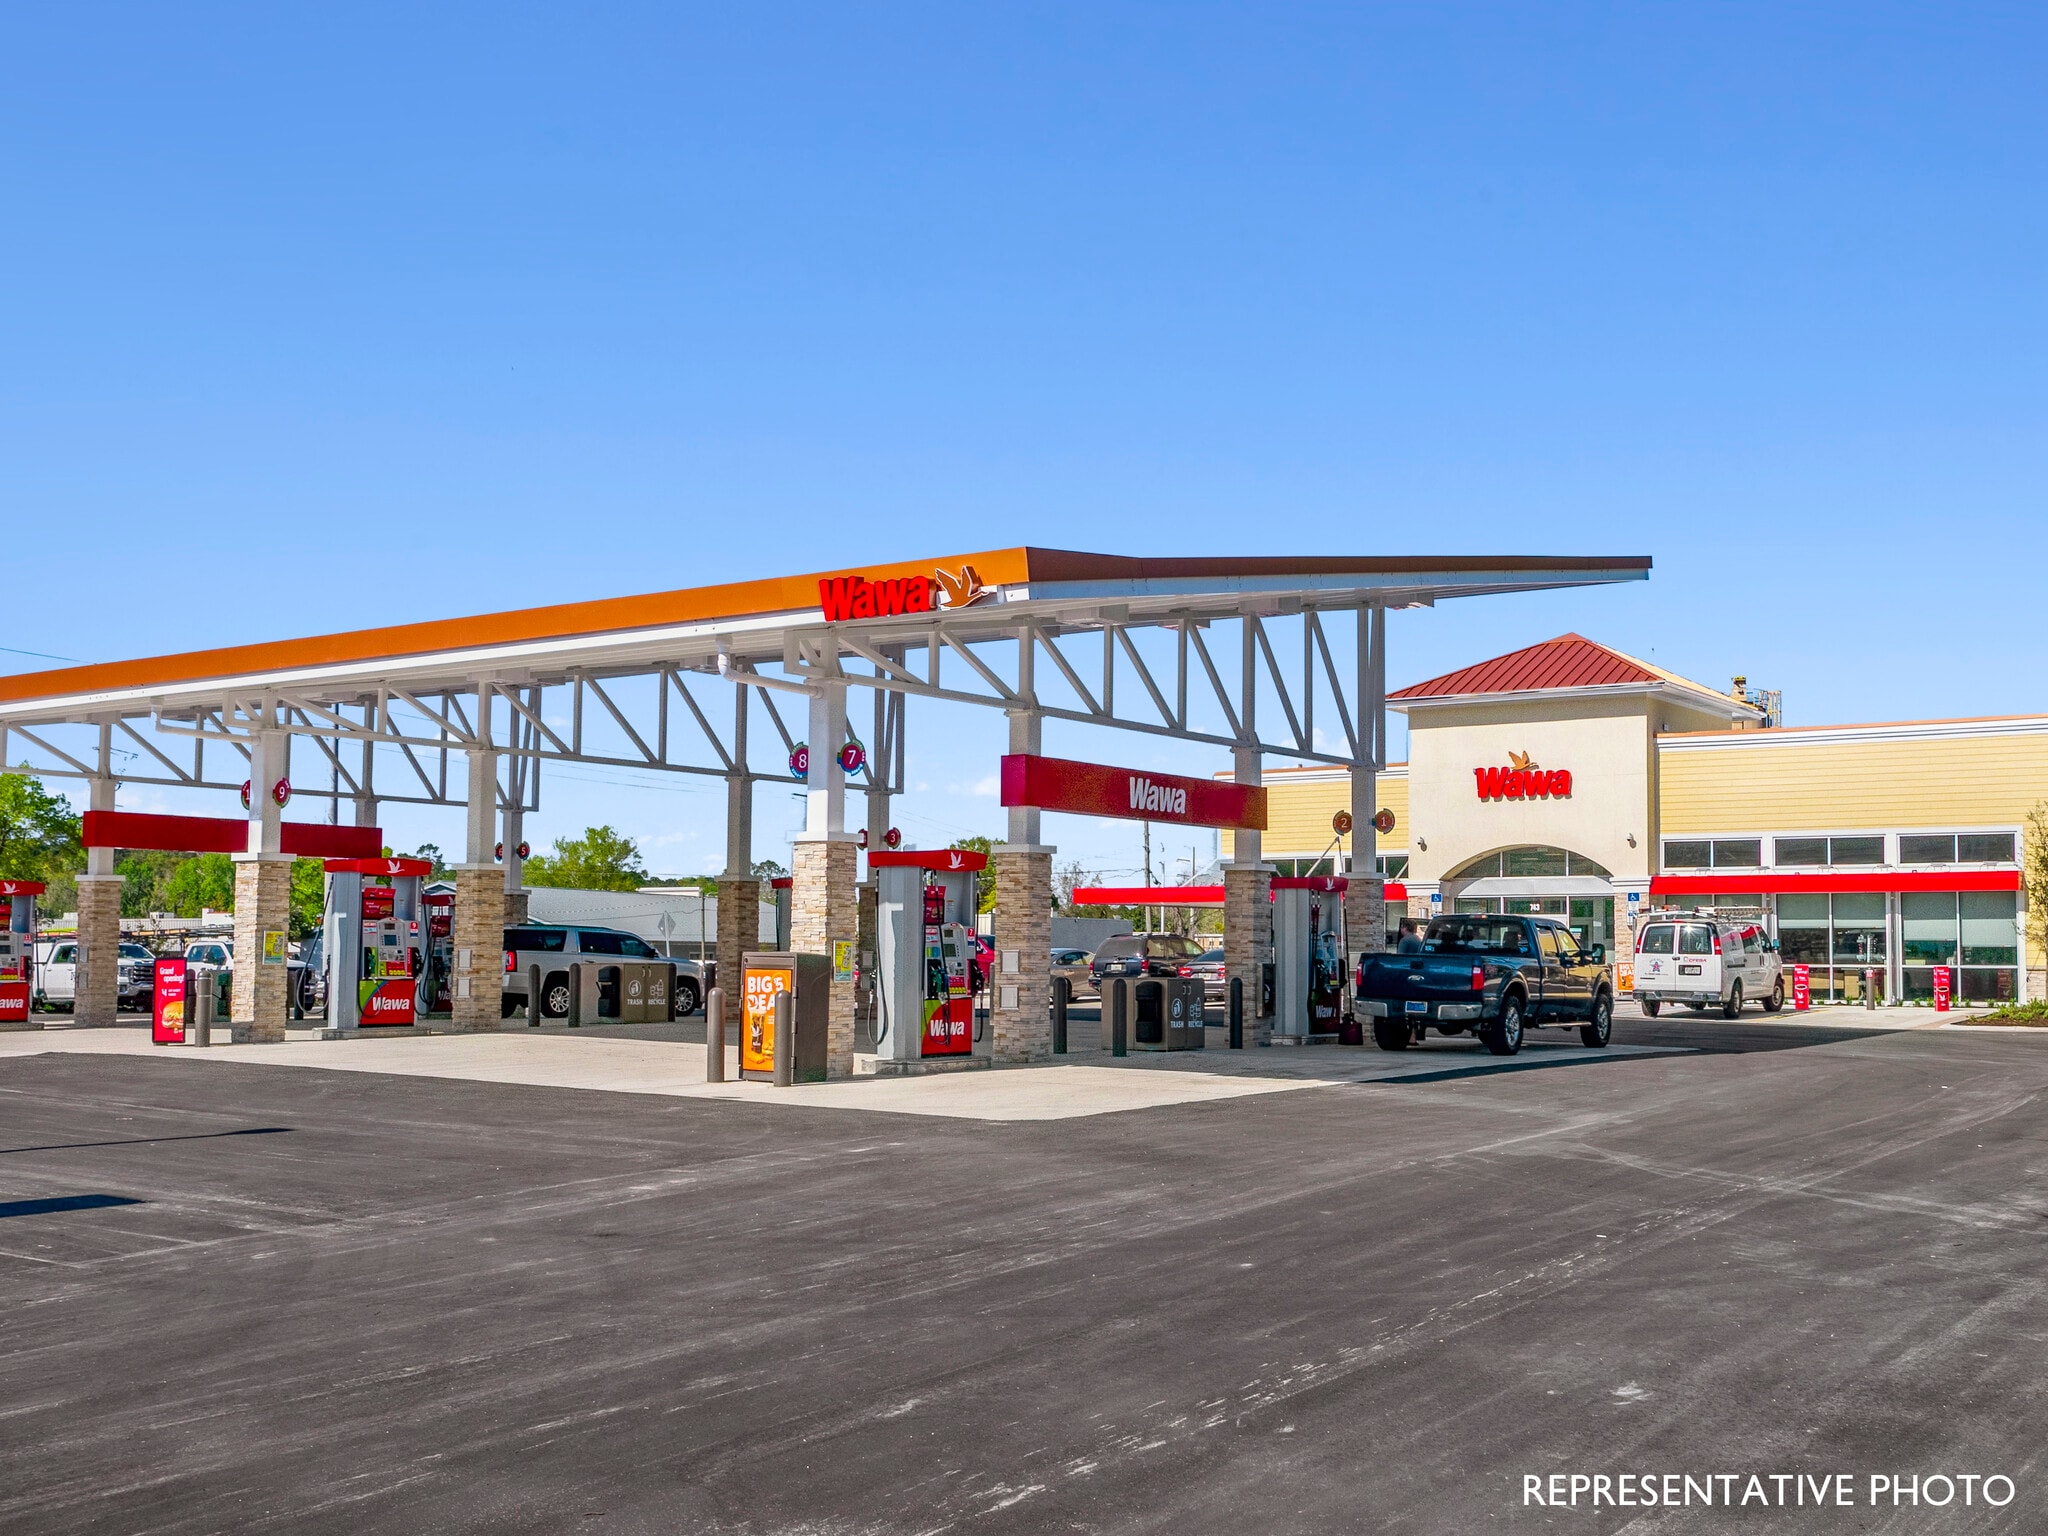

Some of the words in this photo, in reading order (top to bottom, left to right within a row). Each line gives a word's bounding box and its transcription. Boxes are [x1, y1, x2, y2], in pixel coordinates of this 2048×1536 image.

[819, 575, 930, 621] Wawa
[798, 753, 807, 769] 8
[848, 749, 857, 765] 7
[1475, 766, 1571, 799] Wawa
[279, 786, 286, 799] 9
[1129, 776, 1186, 814] Wawa
[1340, 817, 1348, 828] 2
[1381, 816, 1387, 827] 1
[890, 833, 896, 843] 3
[521, 846, 526, 856] 5
[159, 966, 174, 975] Grand
[747, 976, 772, 993] BIG
[0, 999, 24, 1009] awa
[372, 996, 410, 1011] Wawa
[746, 993, 776, 1014] DEA
[930, 1019, 965, 1036] Wawa
[1170, 1020, 1184, 1028] TRASH
[1188, 1020, 1203, 1028] RECYCLE
